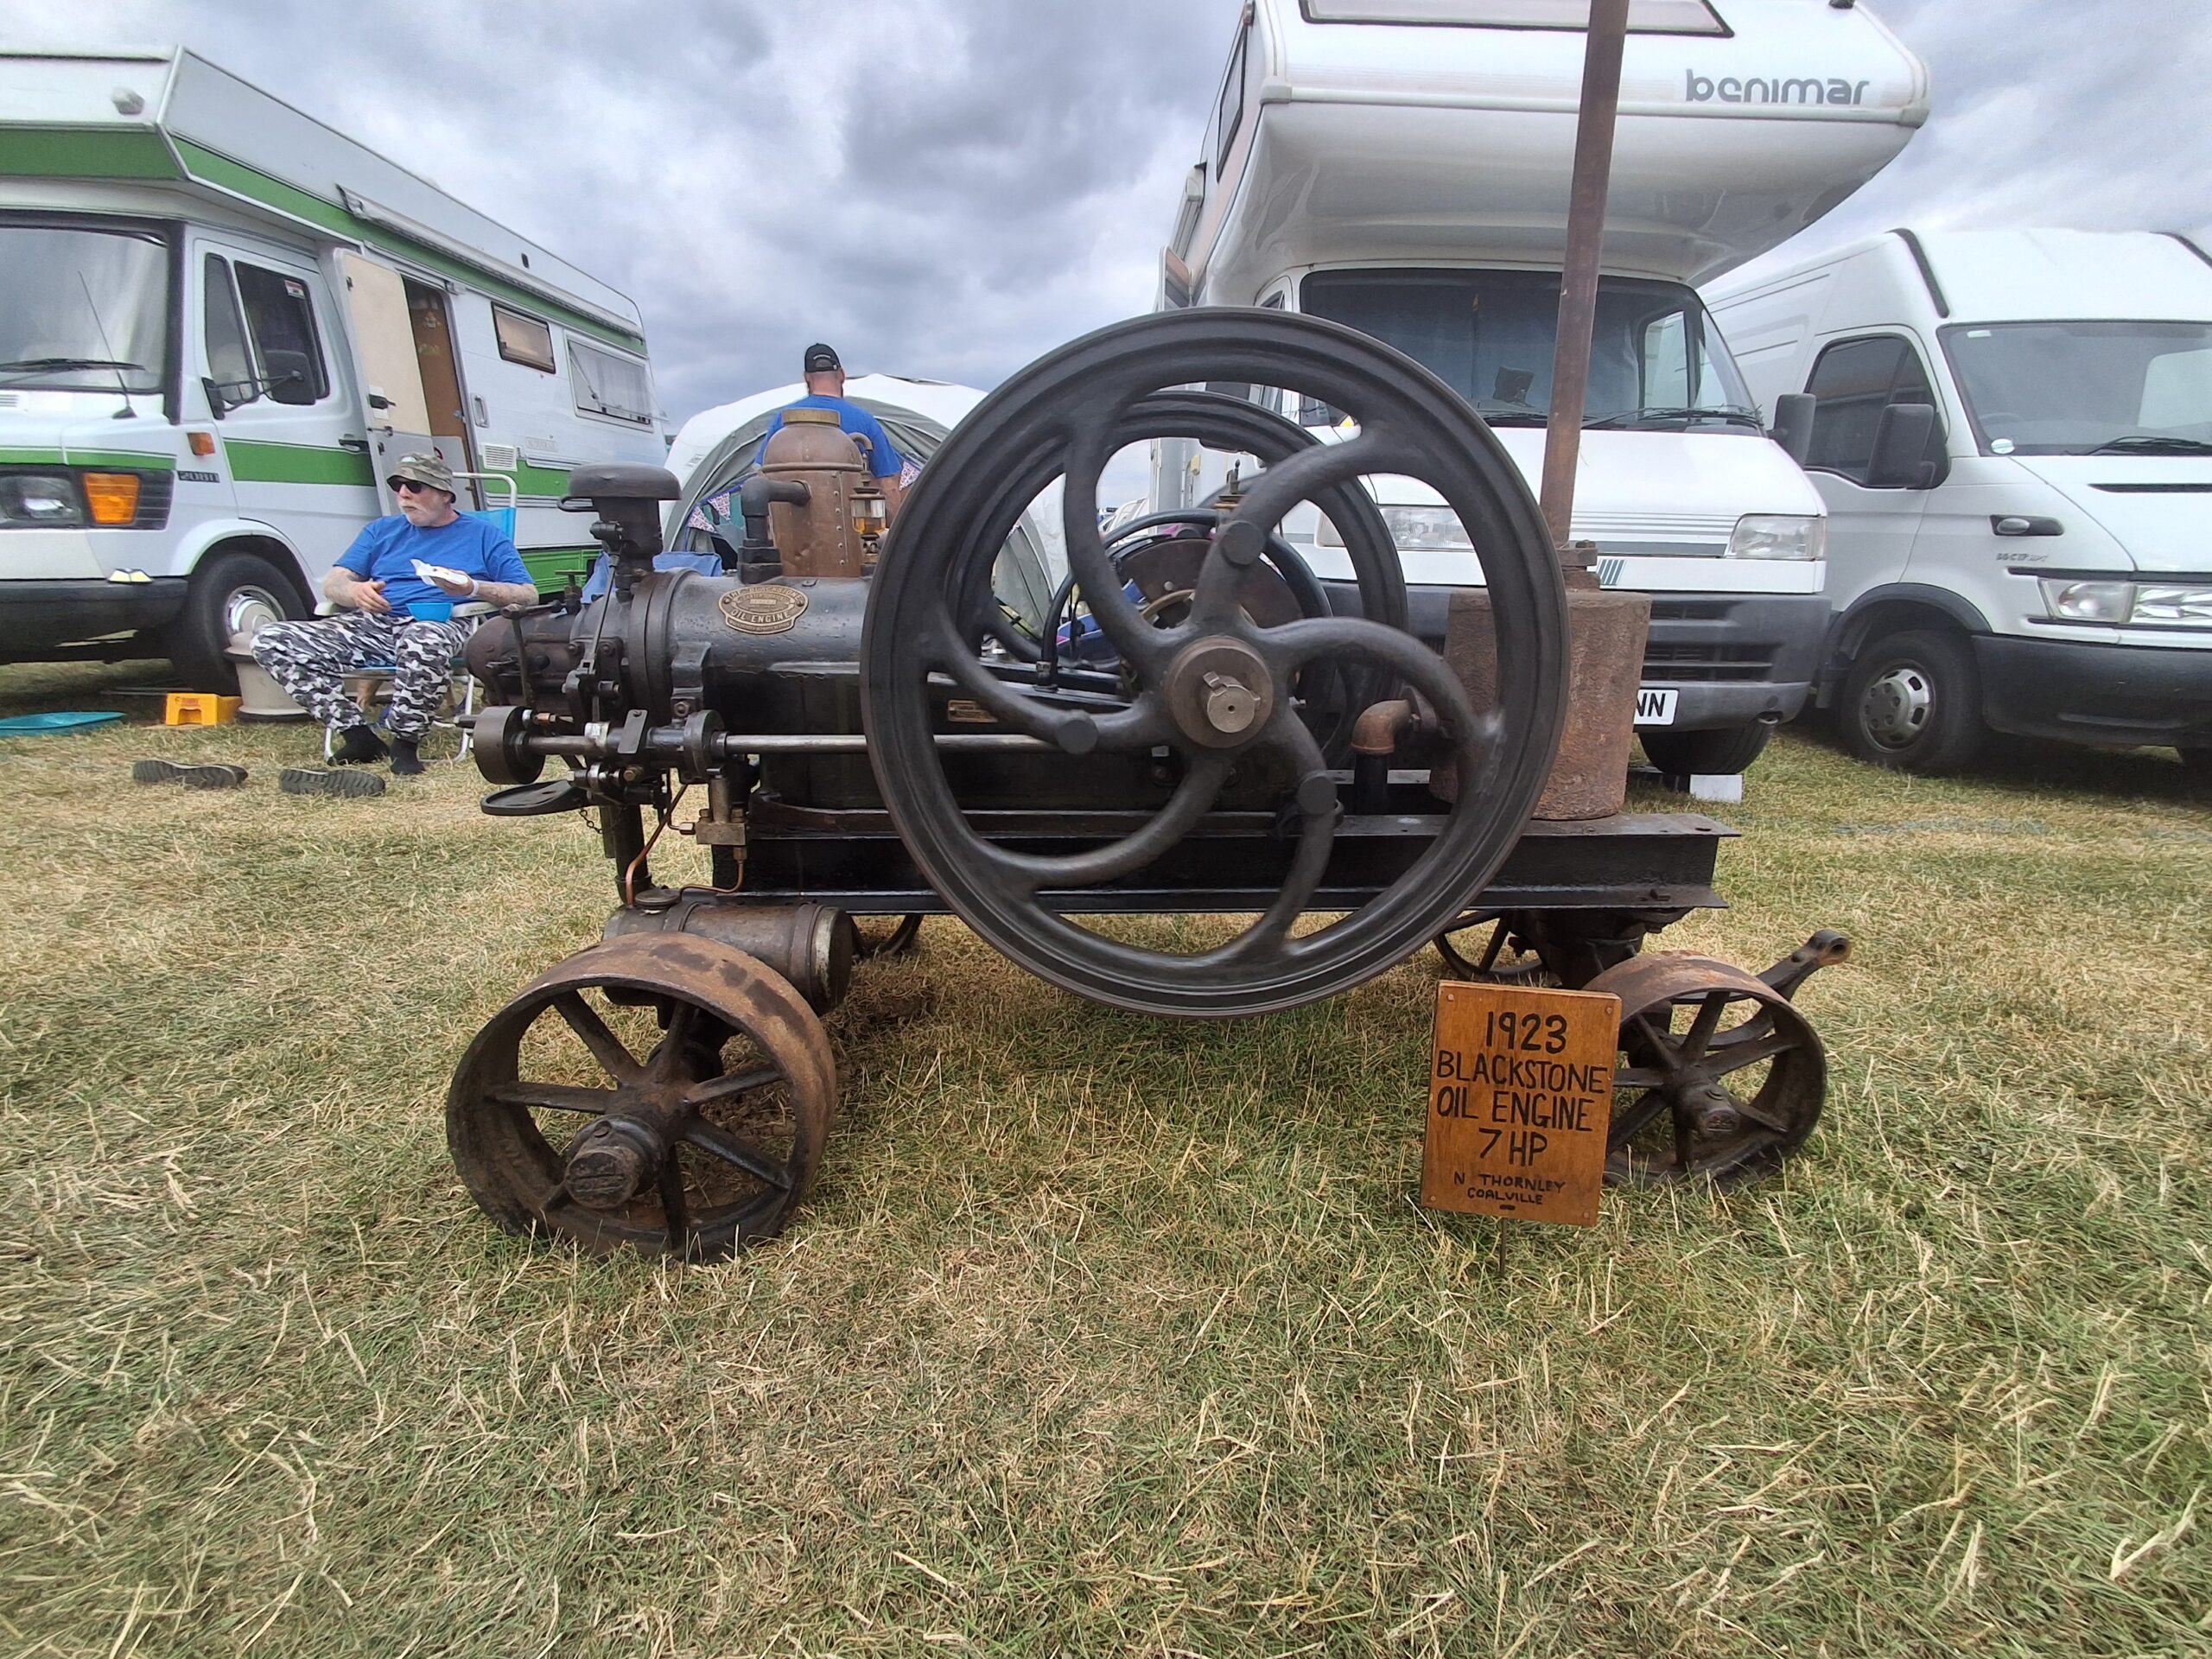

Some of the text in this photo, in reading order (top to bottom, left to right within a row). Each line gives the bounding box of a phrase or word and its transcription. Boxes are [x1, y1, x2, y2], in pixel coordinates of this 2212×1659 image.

[1686, 68, 1870, 105] benimar
[731, 609, 791, 623] OIL ENGINE
[1486, 1011, 1567, 1053] 1923
[1436, 1050, 1608, 1093] BLACKSTONE
[1436, 1085, 1595, 1131] OIL ENGINE
[1478, 1128, 1548, 1166] 7 HP
[1453, 1171, 1566, 1192] N THORNLEY
[1467, 1186, 1543, 1205] COALVILLE
